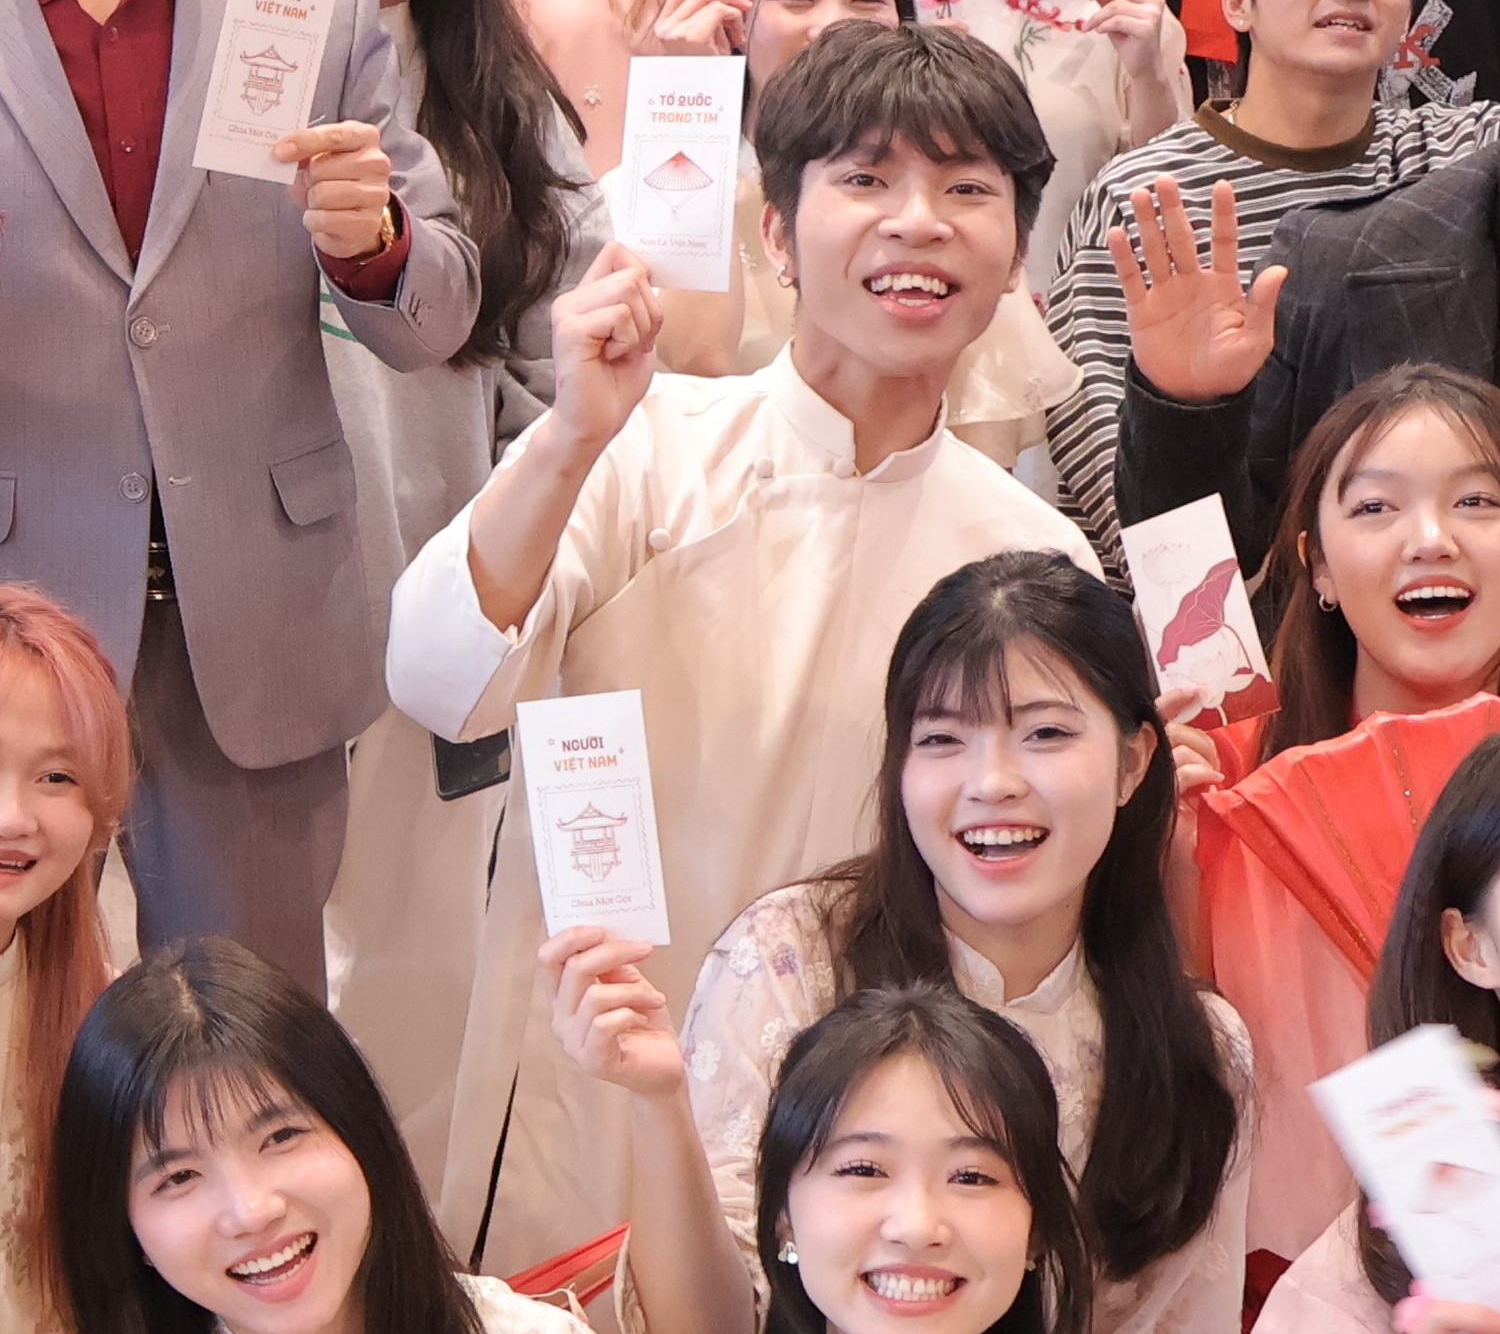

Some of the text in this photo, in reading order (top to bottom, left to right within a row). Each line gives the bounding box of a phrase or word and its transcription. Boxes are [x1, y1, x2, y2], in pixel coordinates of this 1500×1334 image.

[283, 5, 308, 20] NAM
[651, 111, 719, 124] TRONG TIM
[553, 754, 619, 772] VIỆT NAM
